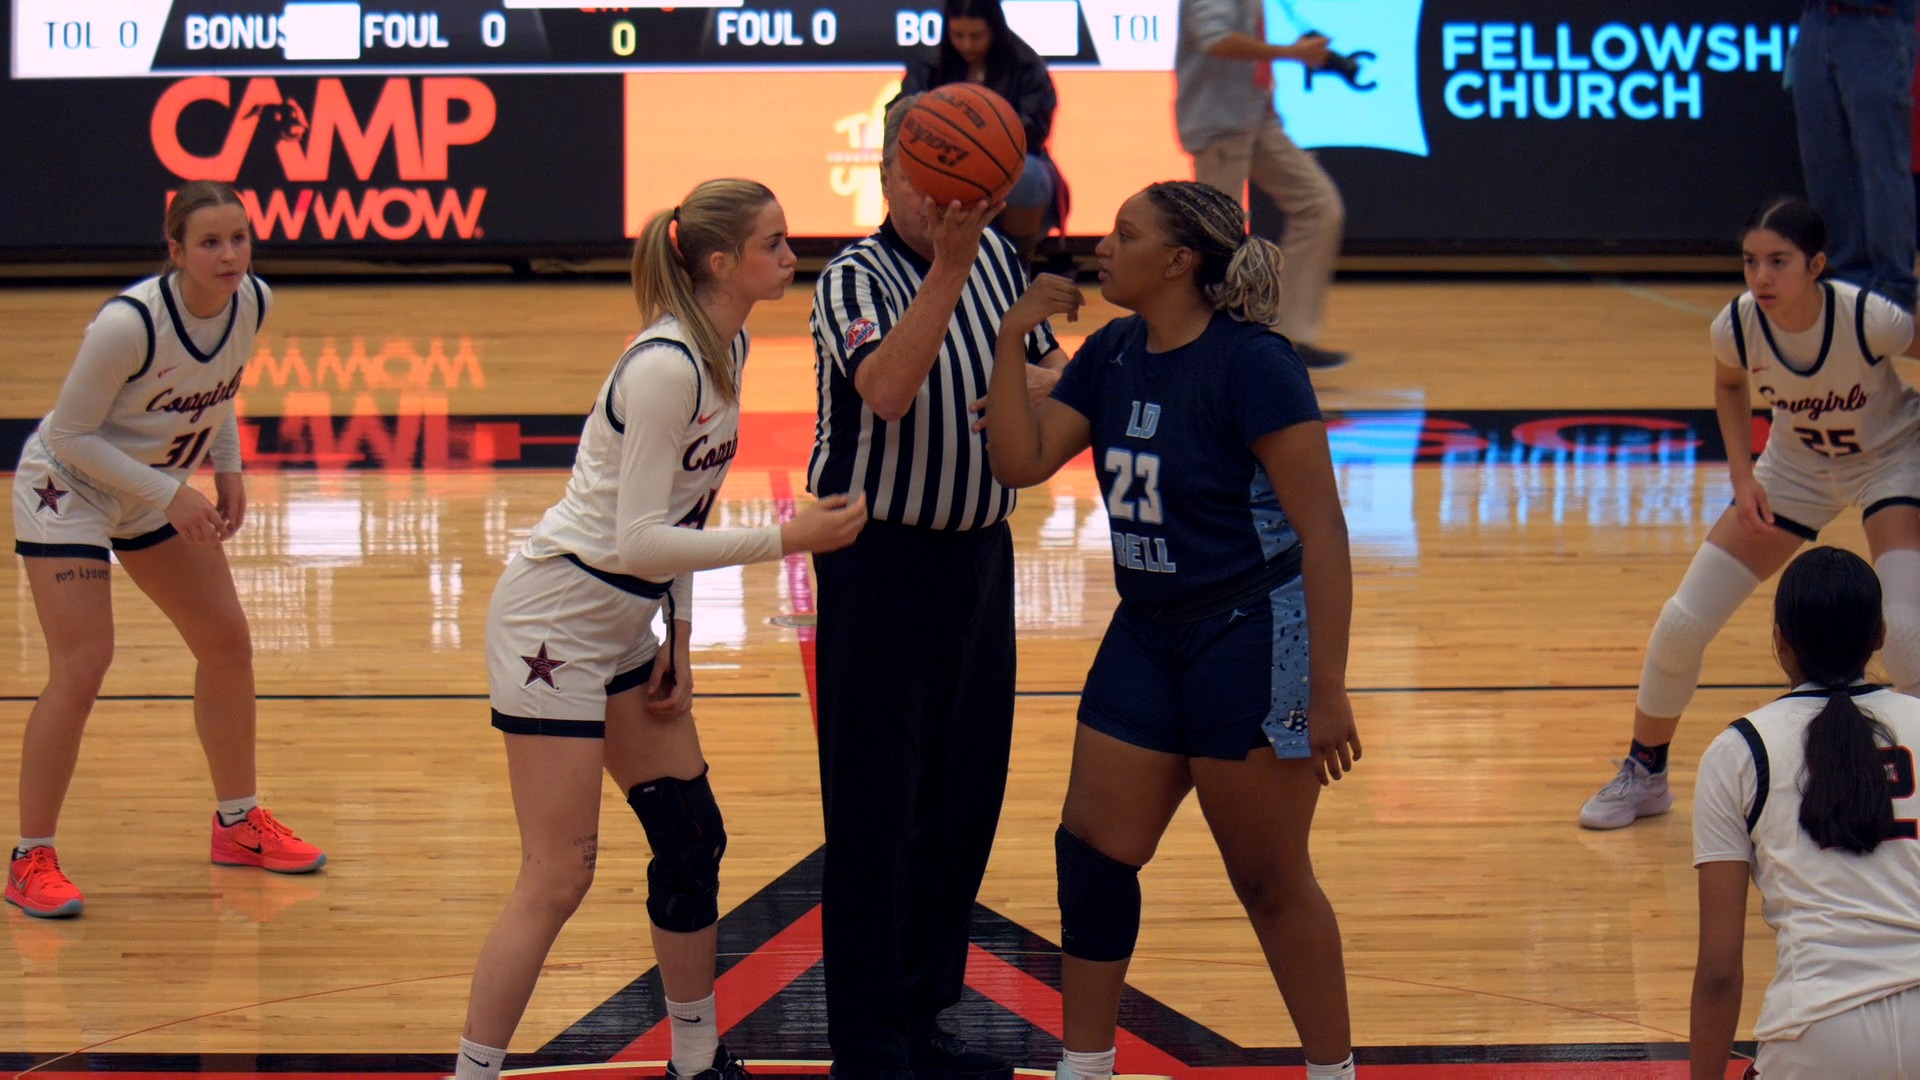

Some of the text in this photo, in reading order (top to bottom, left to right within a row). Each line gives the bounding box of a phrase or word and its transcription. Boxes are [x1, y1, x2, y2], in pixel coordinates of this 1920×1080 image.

[43, 20, 100, 49] TOL
[364, 13, 449, 49] FOUL
[481, 13, 507, 48] 0
[612, 21, 636, 57] 0
[717, 11, 837, 47] FOUL 0
[1442, 22, 1800, 72] FELLOWSH
[1443, 71, 1703, 119] CHURCH
[150, 75, 497, 183] CAMP
[1125, 400, 1161, 439] LD
[150, 426, 213, 469] 31
[1793, 427, 1862, 458] 25
[1105, 446, 1164, 525] 23
[1111, 531, 1176, 573] BELL
